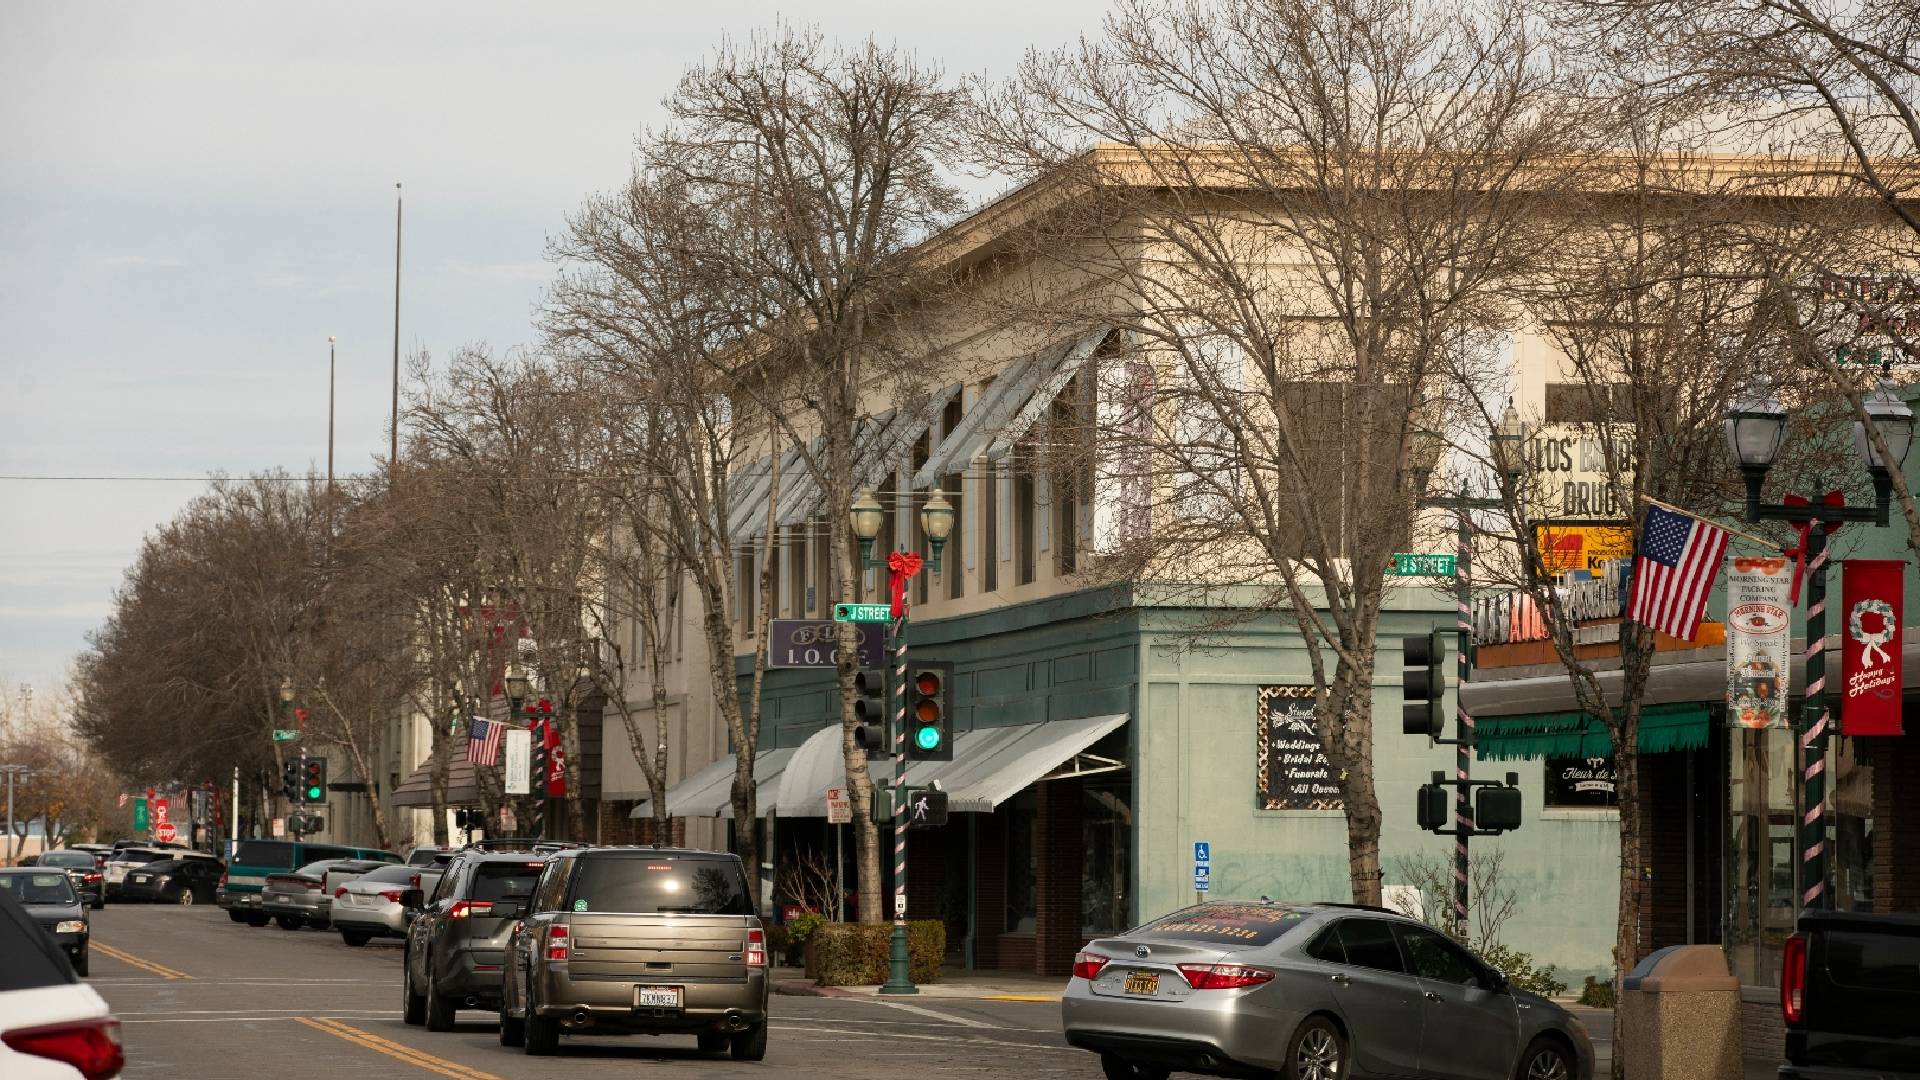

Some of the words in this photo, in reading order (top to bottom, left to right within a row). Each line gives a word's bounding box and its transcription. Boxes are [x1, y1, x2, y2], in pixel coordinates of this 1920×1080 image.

[1535, 438, 1573, 473] LOS
[1580, 438, 1638, 473] BAO
[1563, 481, 1617, 516] DRUG
[1401, 556, 1408, 573] J
[1739, 594, 1779, 602] COMPANY
[850, 606, 857, 620] J
[857, 606, 891, 620] STREET
[1849, 669, 1884, 685] Happy
[1849, 676, 1896, 697] Holidays
[1276, 739, 1320, 753] Weddings
[1288, 767, 1328, 780] Funerals
[1562, 767, 1594, 779] Fleur
